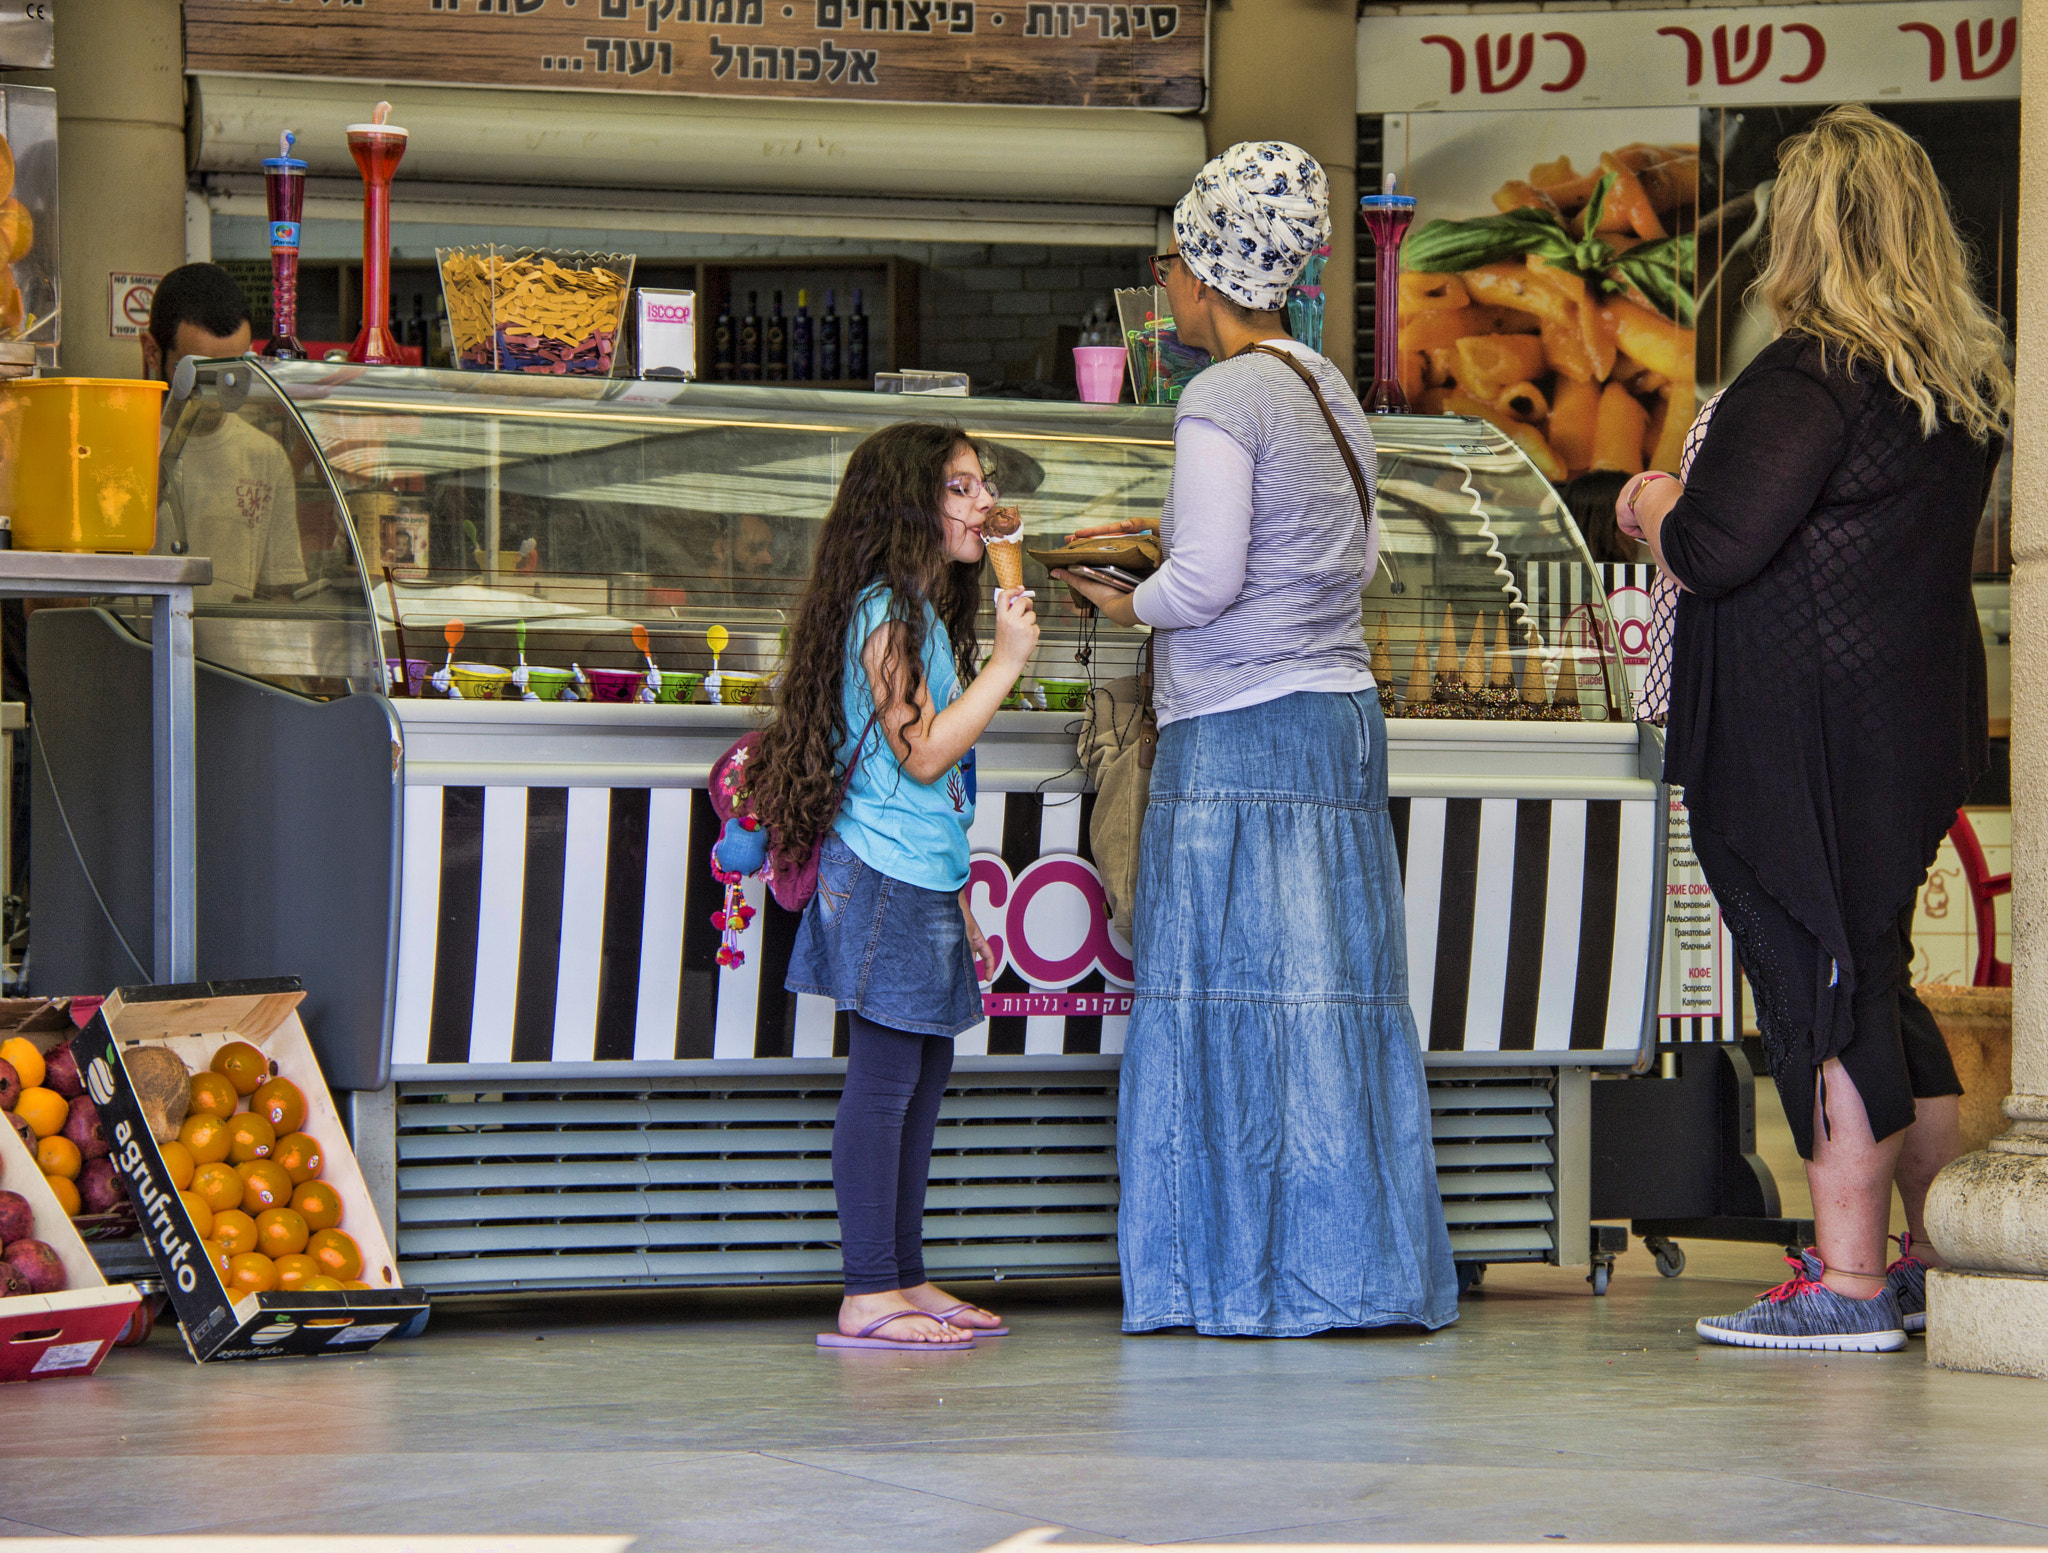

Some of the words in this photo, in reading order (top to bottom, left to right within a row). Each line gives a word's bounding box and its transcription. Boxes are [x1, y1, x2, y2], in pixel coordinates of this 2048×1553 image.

[26, 3, 45, 20] CE
[815, 0, 975, 35] פיצוחים
[1023, 3, 1178, 41] סיגריות
[1656, 23, 1827, 87] כשר
[1897, 15, 2018, 83] שר
[709, 35, 878, 85] אלכוהול
[1420, 31, 1587, 95] כשר
[114, 276, 127, 285] NO
[129, 276, 161, 286] SMOKIN
[1688, 884, 1711, 896] СОКИ
[1674, 899, 1711, 910] Морковный
[1666, 914, 1711, 924] Апельсиновый
[1675, 927, 1711, 939] Гранатовый
[1680, 941, 1711, 952] Яблочный
[1688, 967, 1711, 979] КОФЕ
[1682, 984, 1711, 994] Эспрессо
[1002, 995, 1058, 1012] גלידות
[114, 1119, 196, 1293] agrufruto
